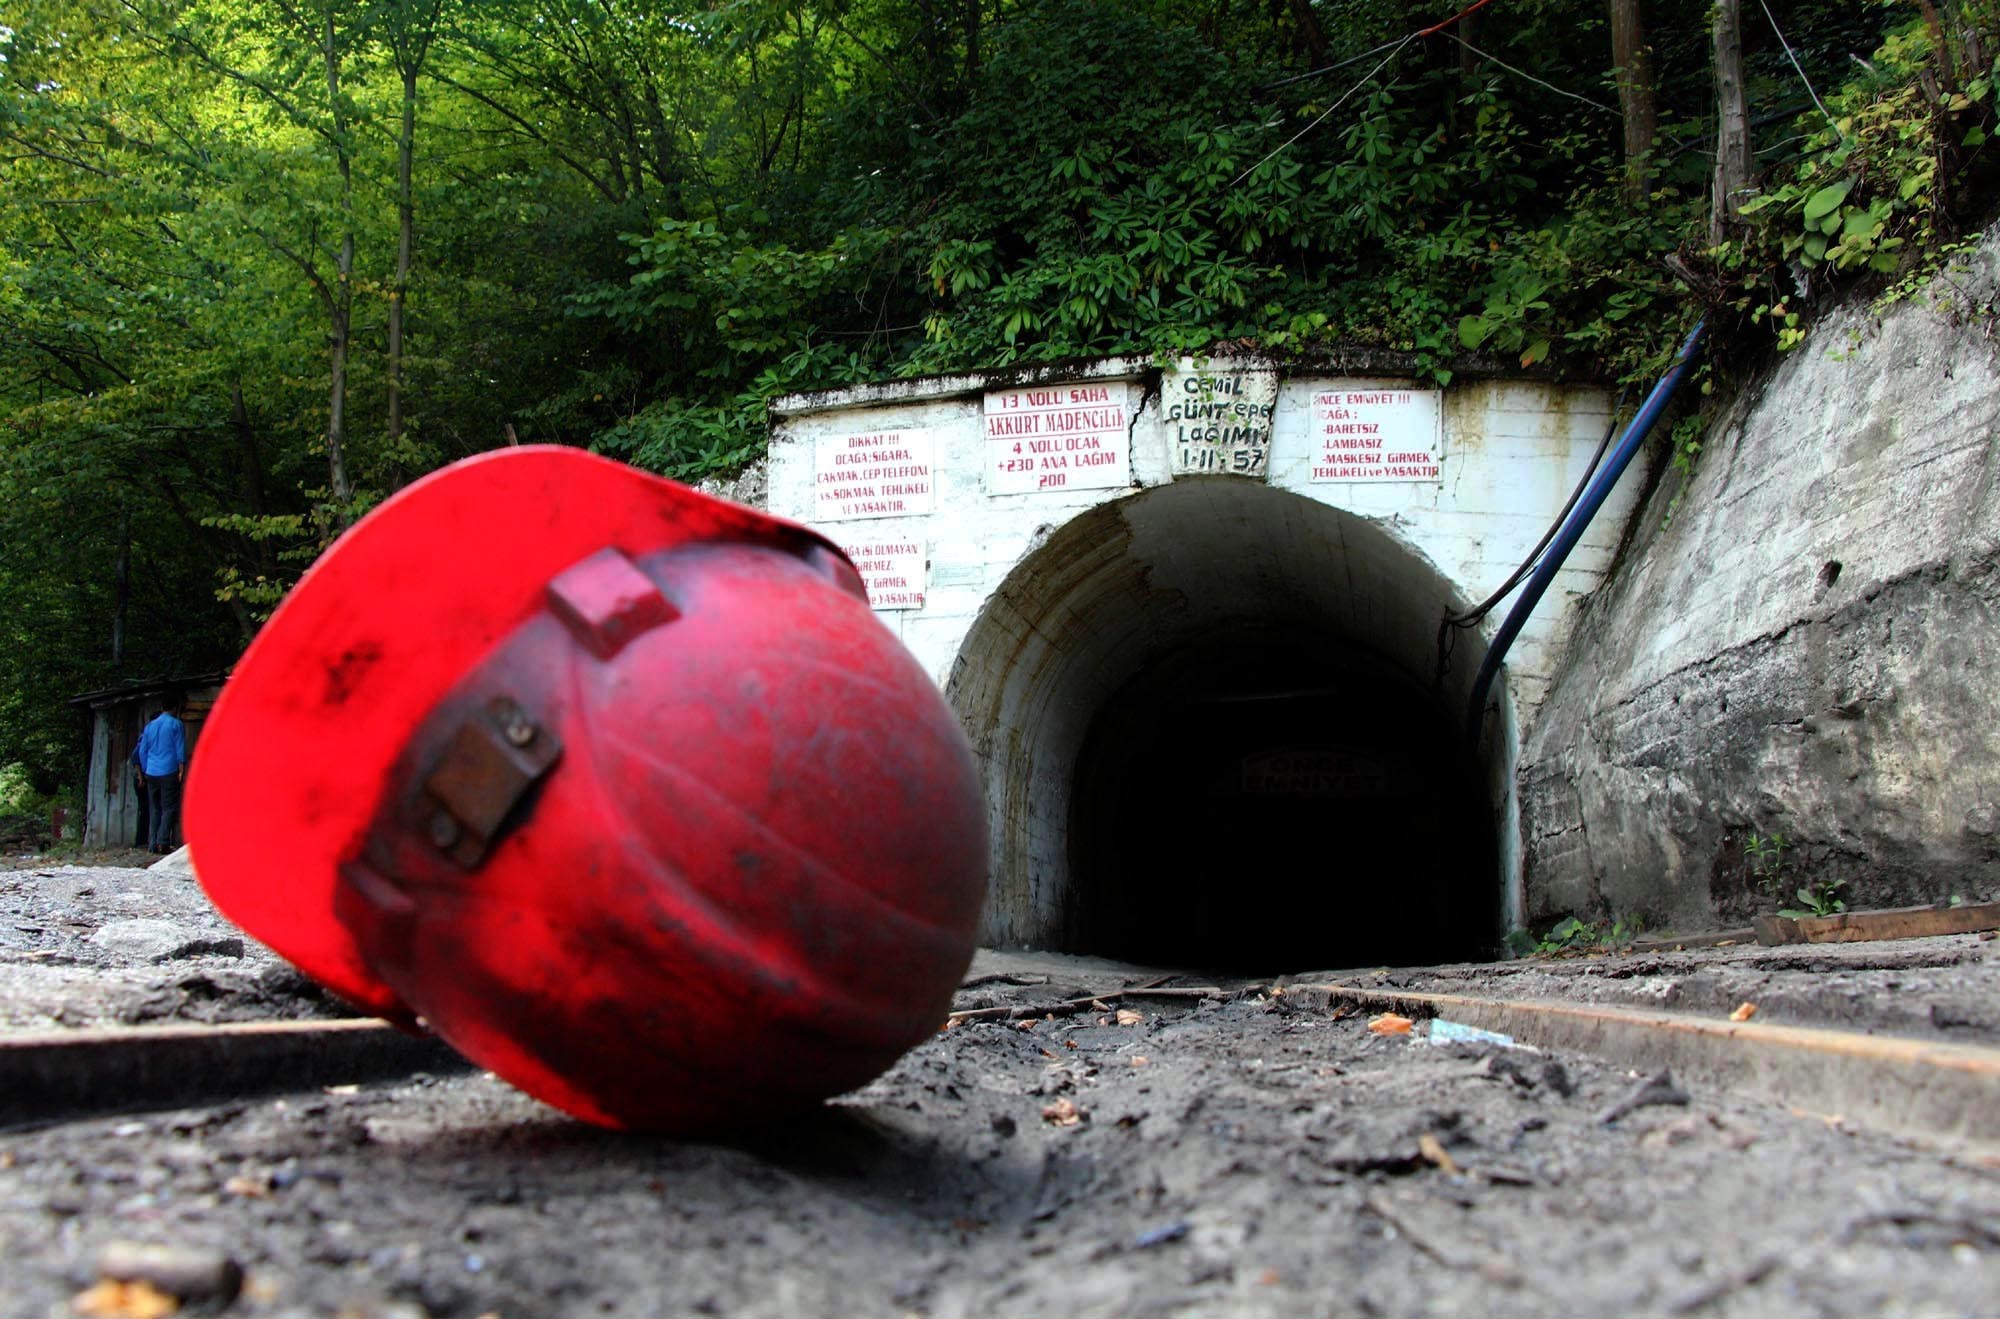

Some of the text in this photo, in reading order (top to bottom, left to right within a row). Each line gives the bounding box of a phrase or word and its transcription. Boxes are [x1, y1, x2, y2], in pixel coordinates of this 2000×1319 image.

[1001, 387, 1108, 408] 13 NOLU SAHA
[988, 414, 1040, 436] AKKURT
[1013, 436, 1100, 454] 4 NOLU OCAK
[998, 450, 1115, 472] +230 ANA LAĞIM
[1039, 474, 1066, 488] 200
[875, 543, 918, 555] OLMAYAN
